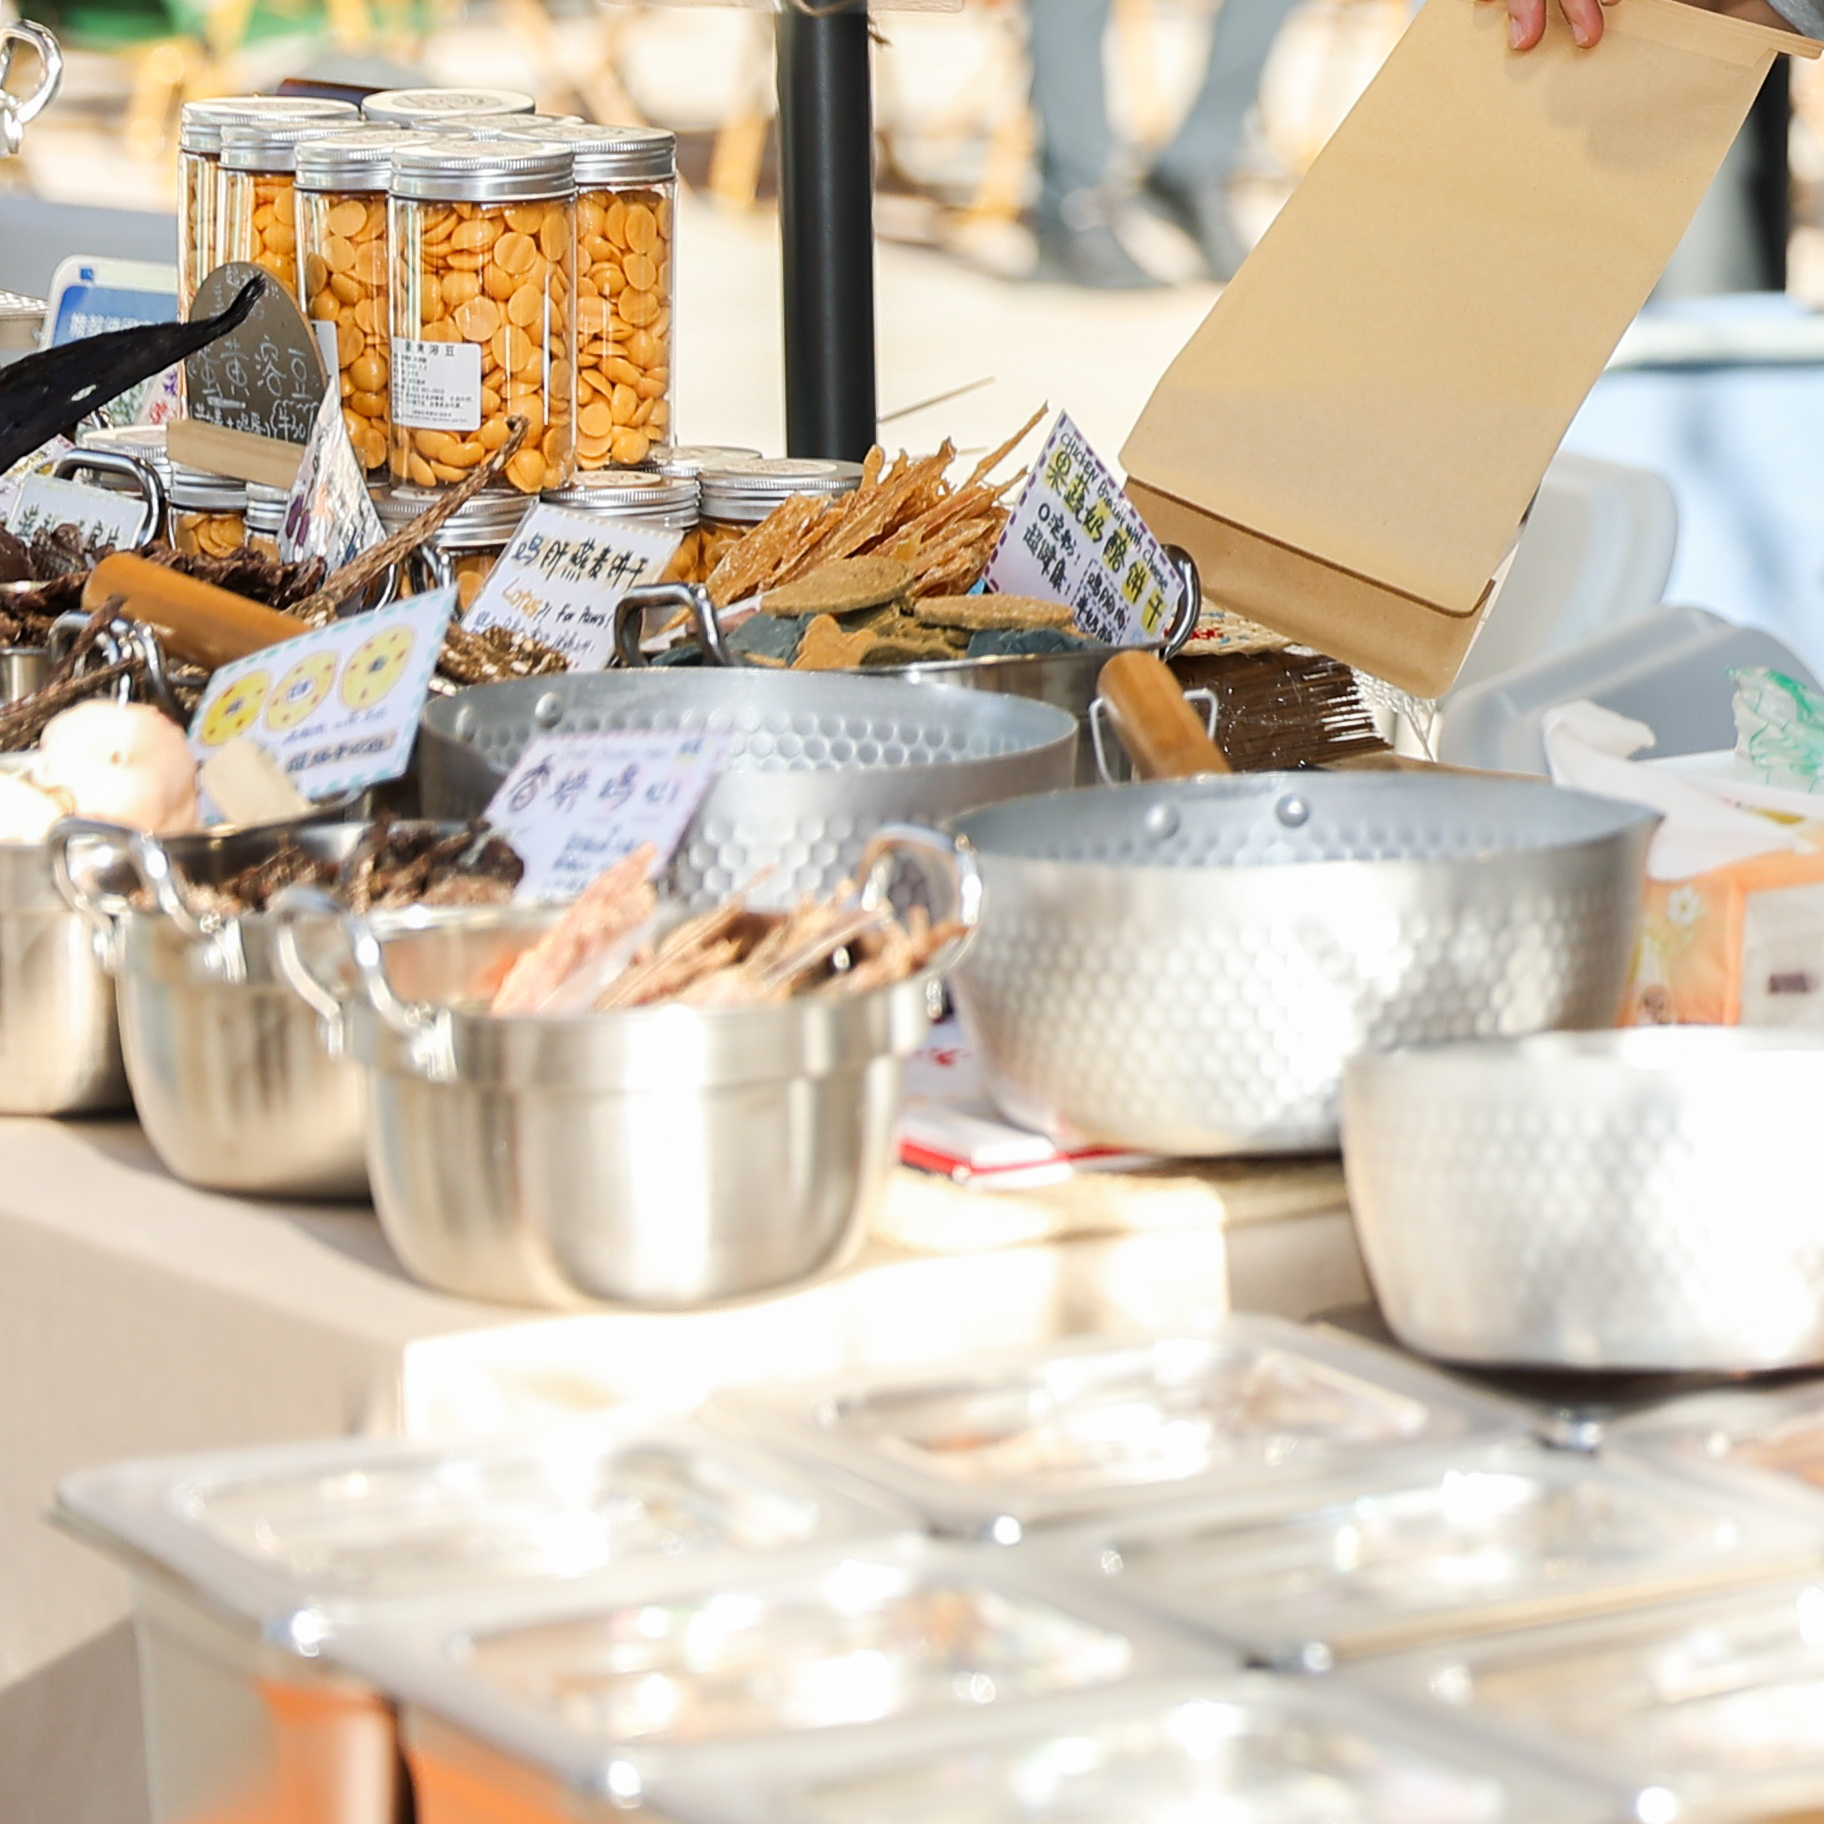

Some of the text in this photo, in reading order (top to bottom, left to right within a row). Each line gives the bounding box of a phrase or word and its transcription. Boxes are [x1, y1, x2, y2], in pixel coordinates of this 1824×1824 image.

[1046, 450, 1164, 629] 果蔬奶酪饼干
